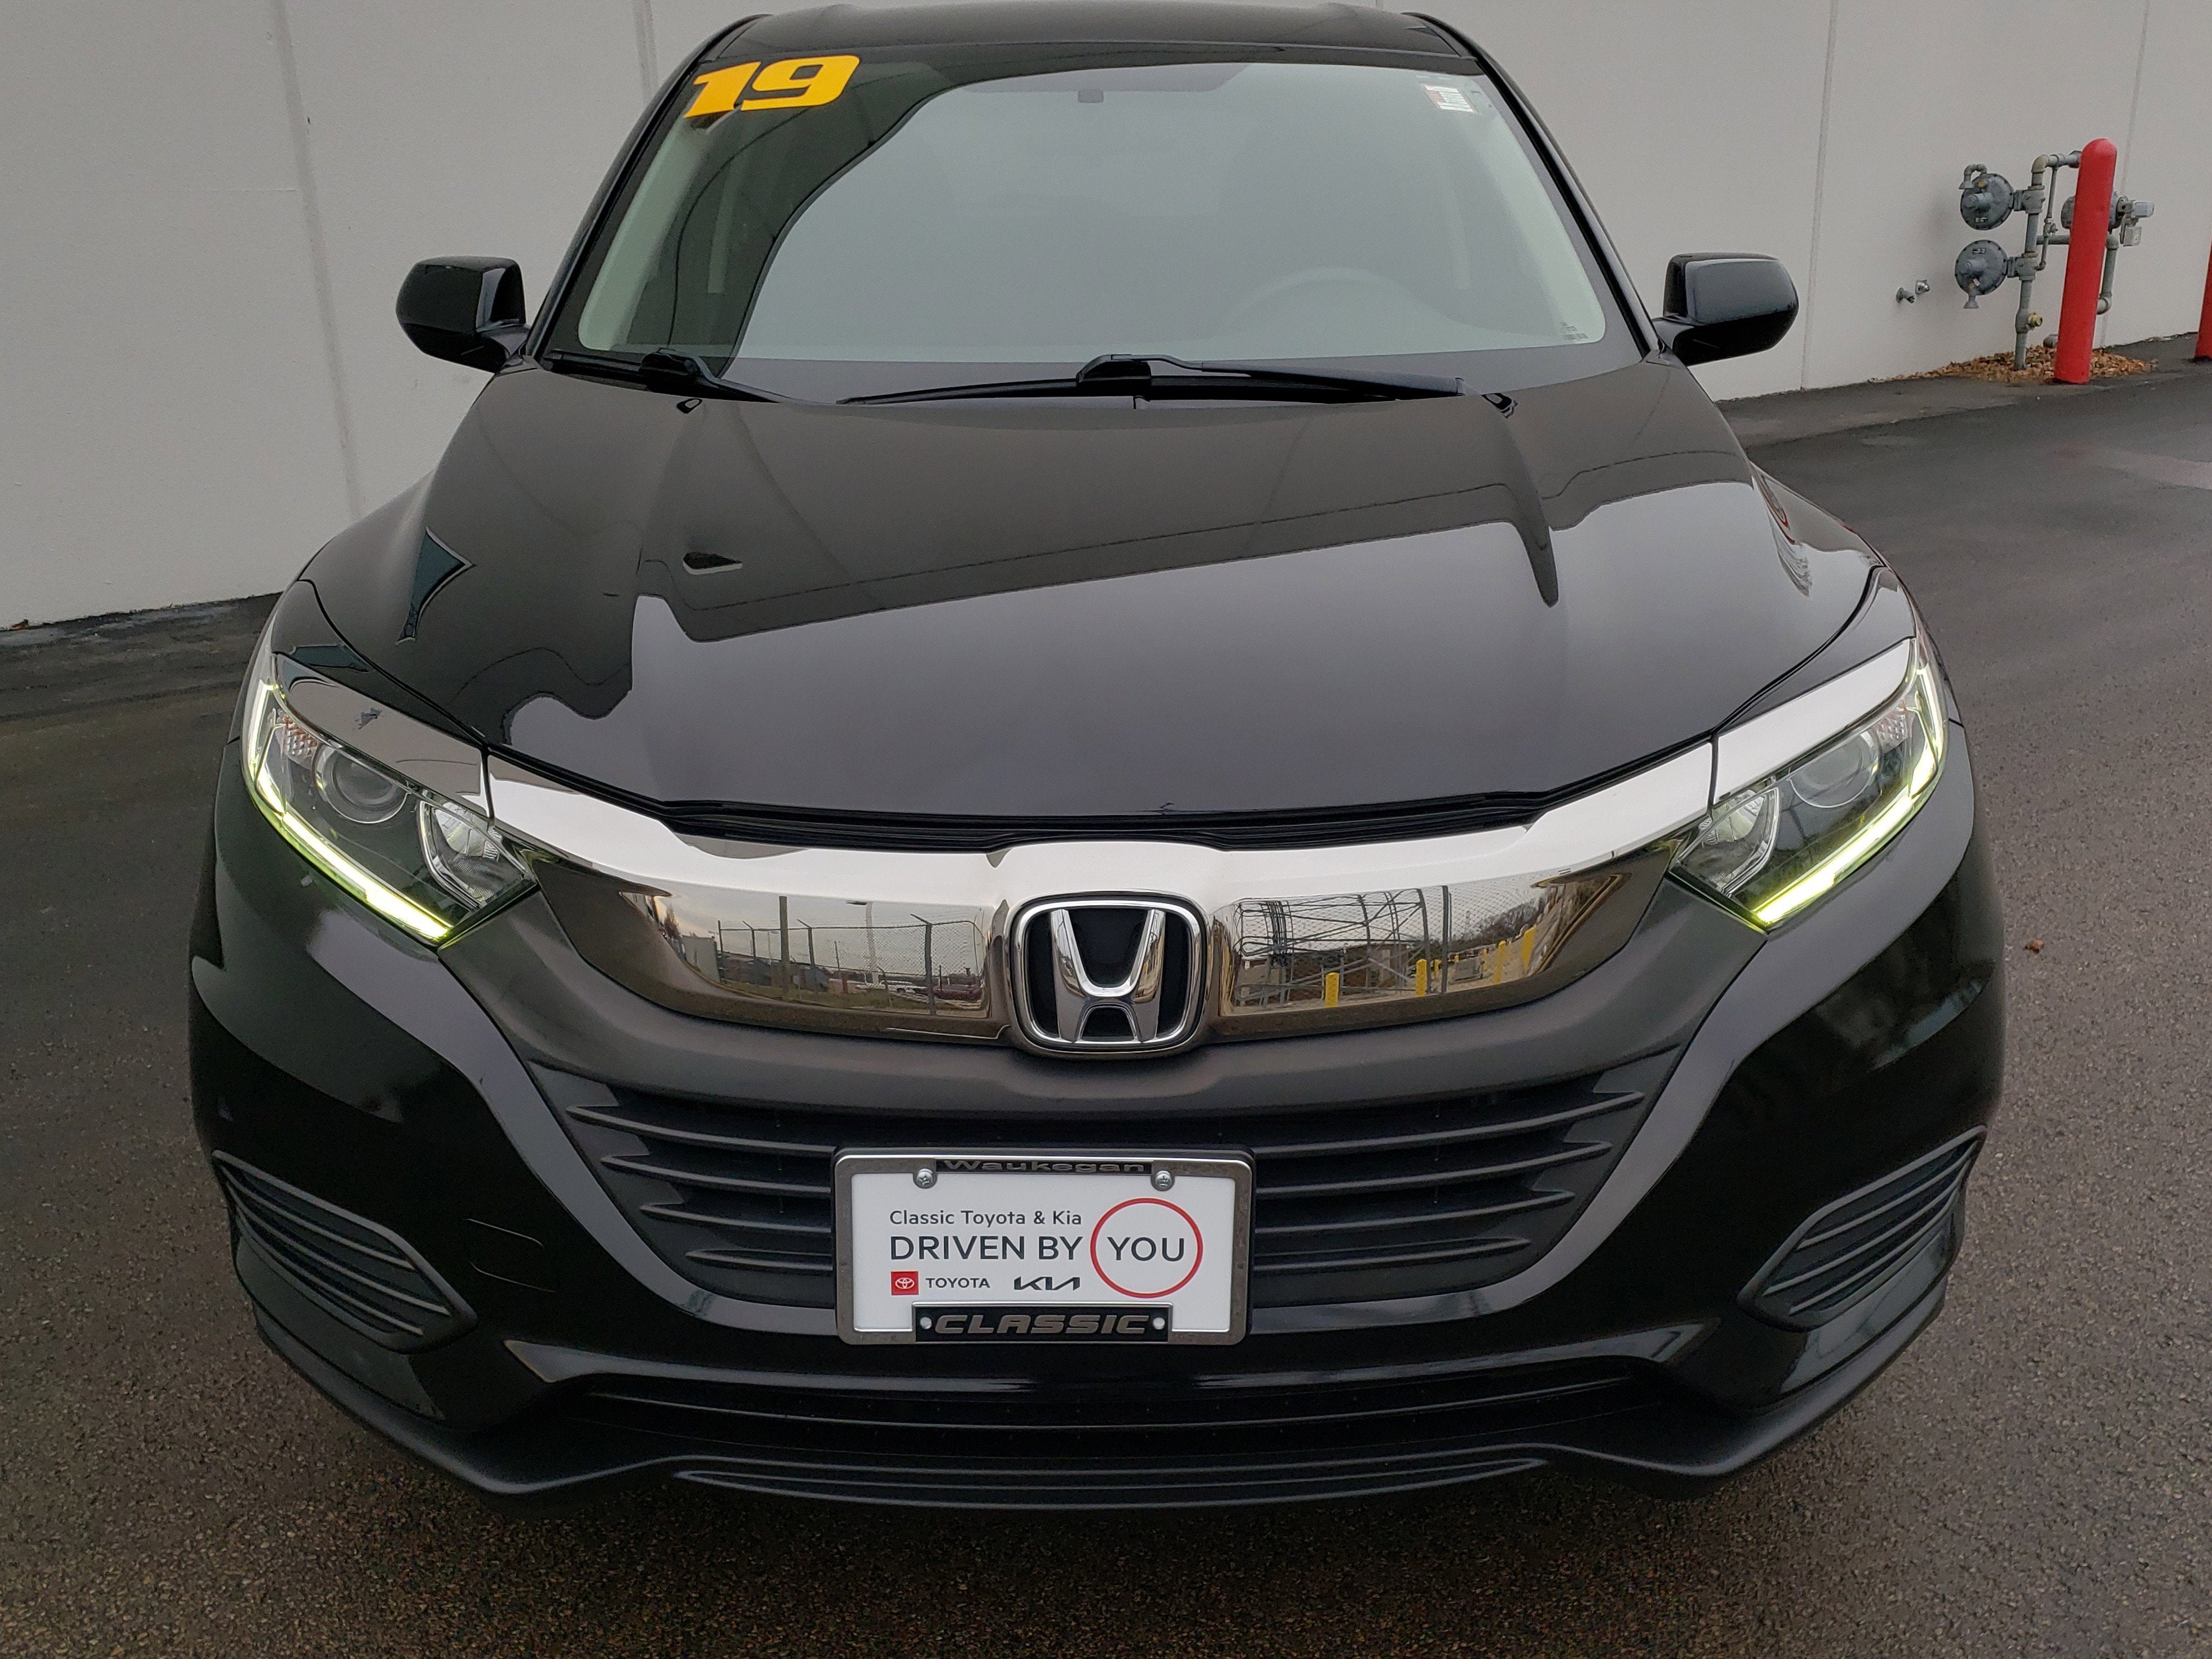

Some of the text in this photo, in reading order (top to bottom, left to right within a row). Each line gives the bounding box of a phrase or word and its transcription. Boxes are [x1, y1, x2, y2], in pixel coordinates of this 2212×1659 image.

[683, 54, 860, 118] 19
[944, 1160, 1144, 1173] Waukegan
[889, 1210, 1082, 1228] Classic Toyota & Kia
[890, 1235, 1185, 1262] DRIVEN BY YOU
[926, 1277, 991, 1289] TOYOTA
[934, 1314, 1149, 1334] CLASSIC
